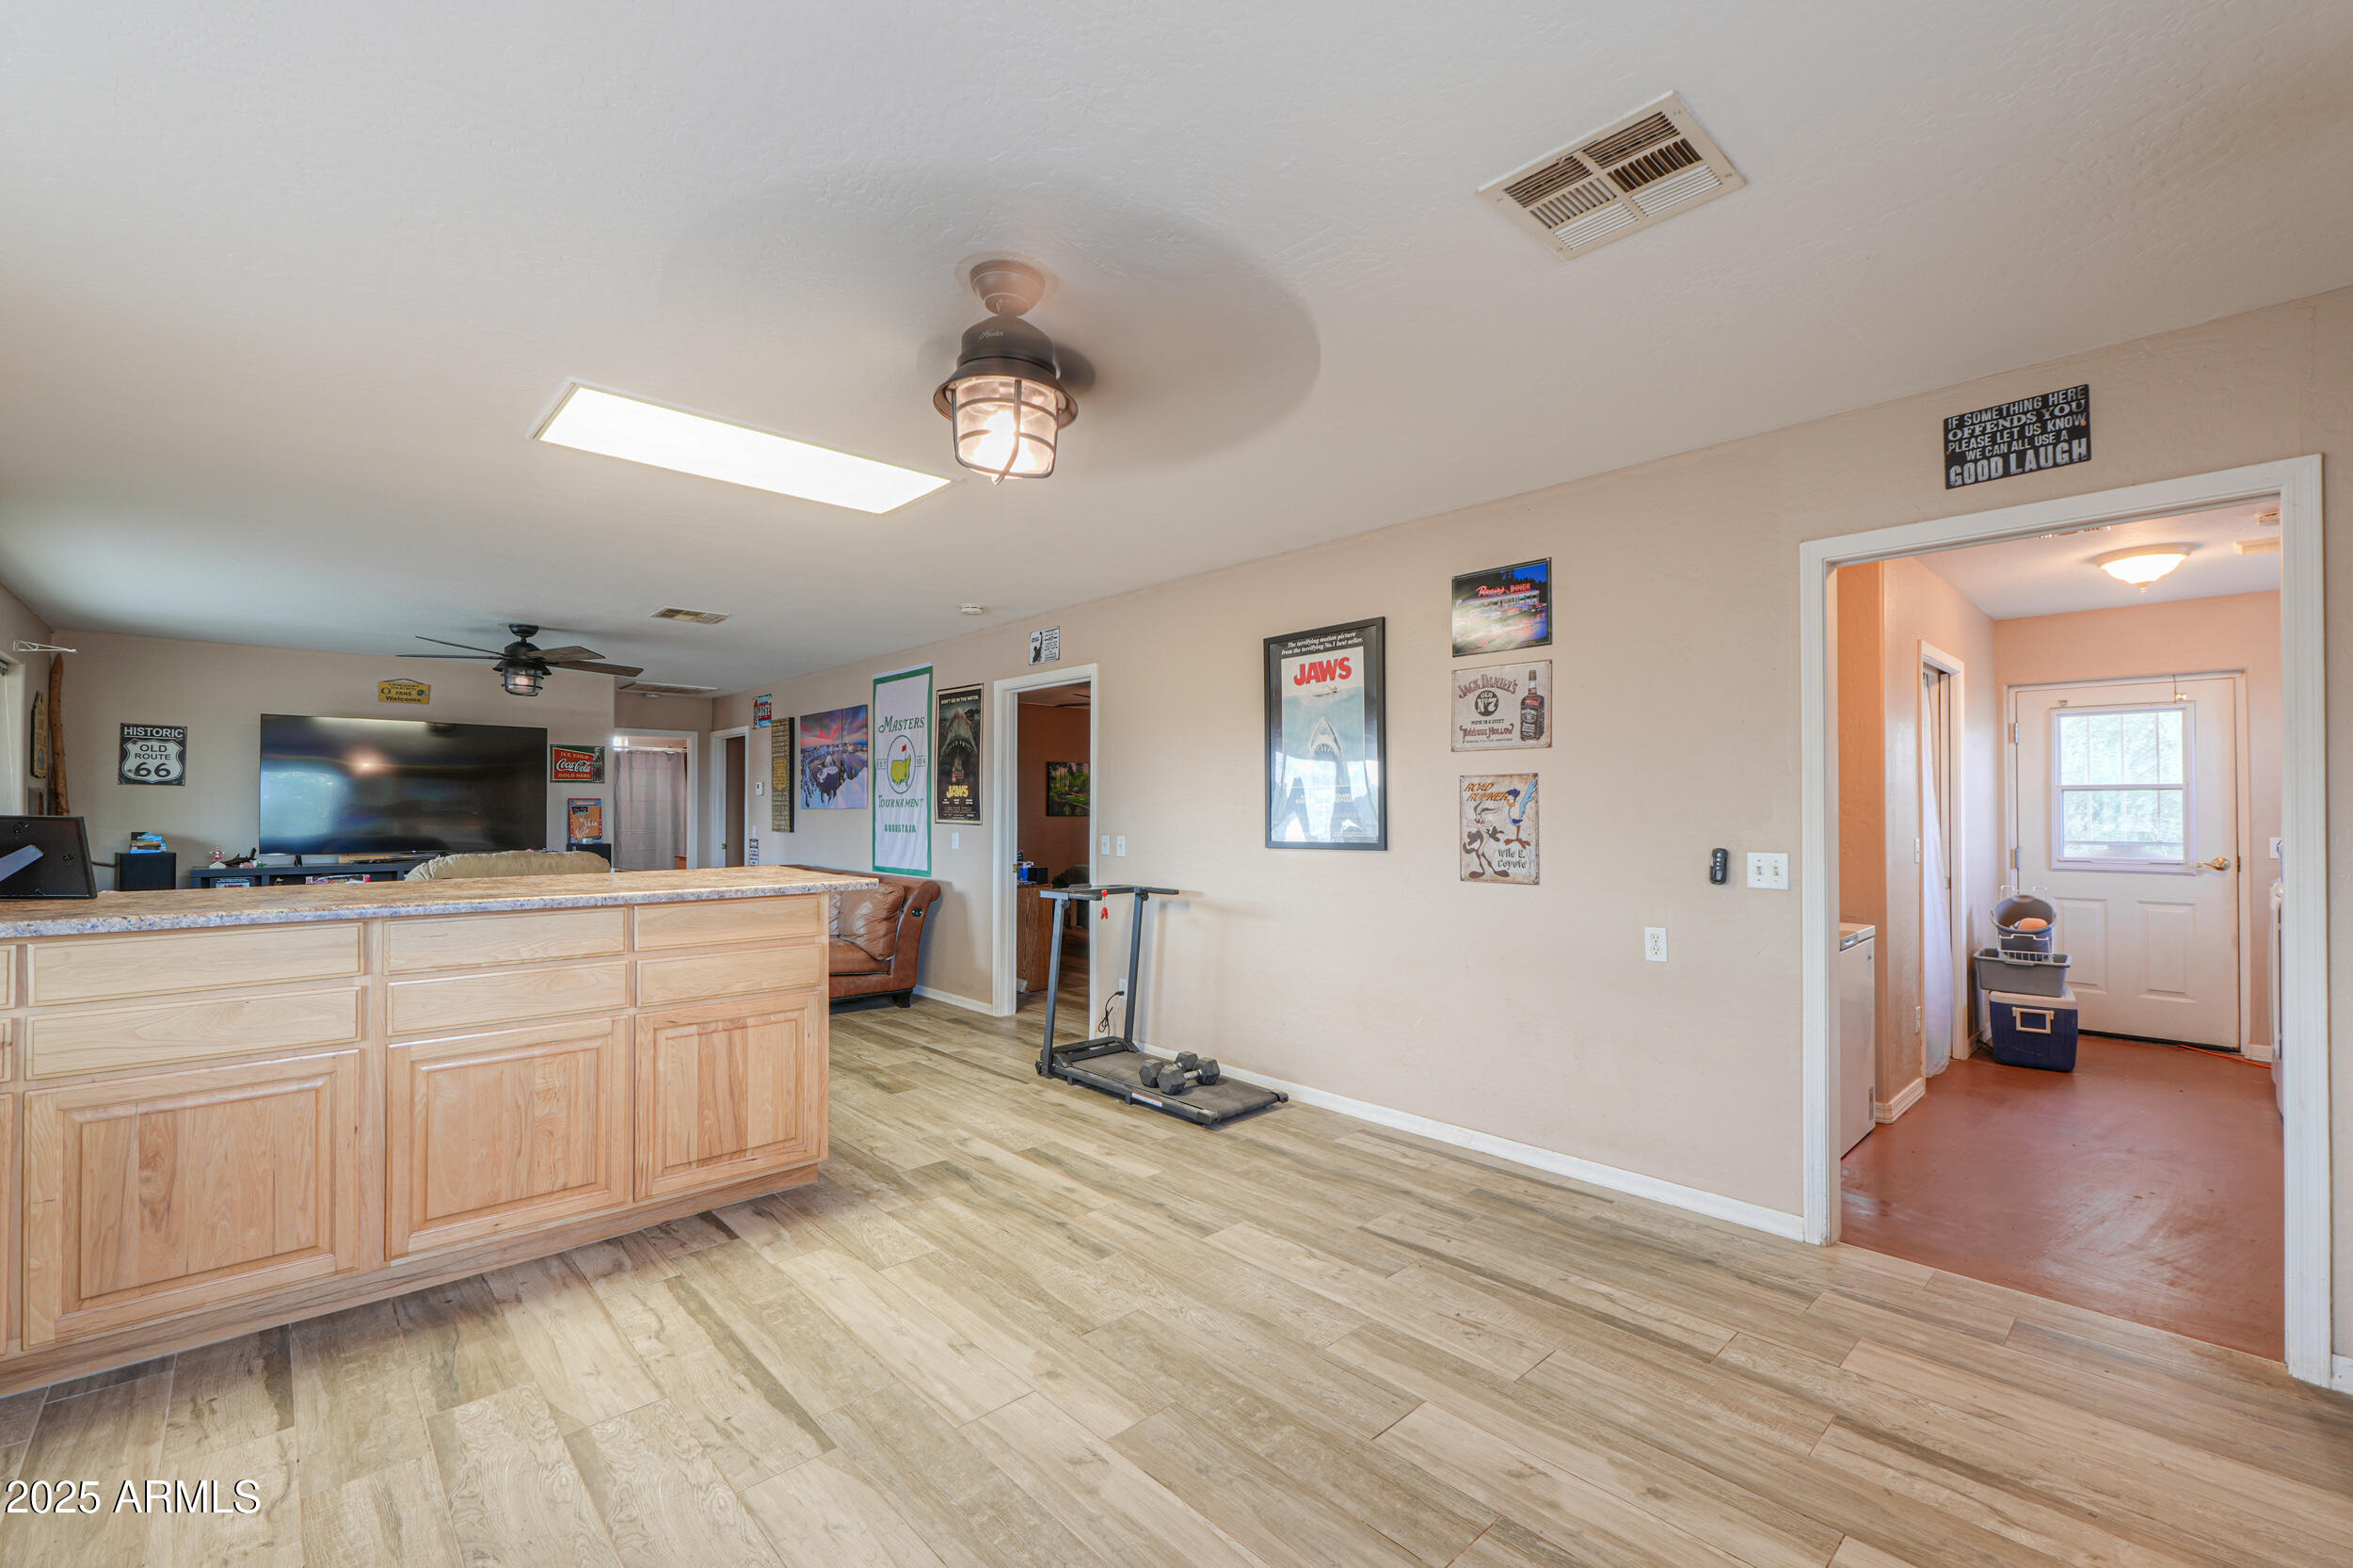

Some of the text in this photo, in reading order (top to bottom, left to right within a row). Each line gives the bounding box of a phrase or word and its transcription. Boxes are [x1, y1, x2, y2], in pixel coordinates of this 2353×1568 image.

[1948, 386, 2086, 430] IF SOMETHING HERE
[1948, 400, 2086, 441] OFFENDS YOU
[1948, 413, 2087, 452] PLEASE LET US KNOW
[1966, 430, 2068, 461] WE CAN ALL USE A
[1949, 437, 2087, 487] GOOD LAUGH
[1294, 657, 1352, 685] JAWS
[1457, 679, 1481, 698] JACK
[124, 727, 183, 737] HISTORIC
[134, 762, 171, 777] 66
[946, 785, 969, 798] JAWS
[1464, 781, 1497, 792] ROAD
[1467, 792, 1509, 801] RUNNER
[1498, 848, 1515, 858] Wile
[1497, 859, 1526, 870] Coyote
